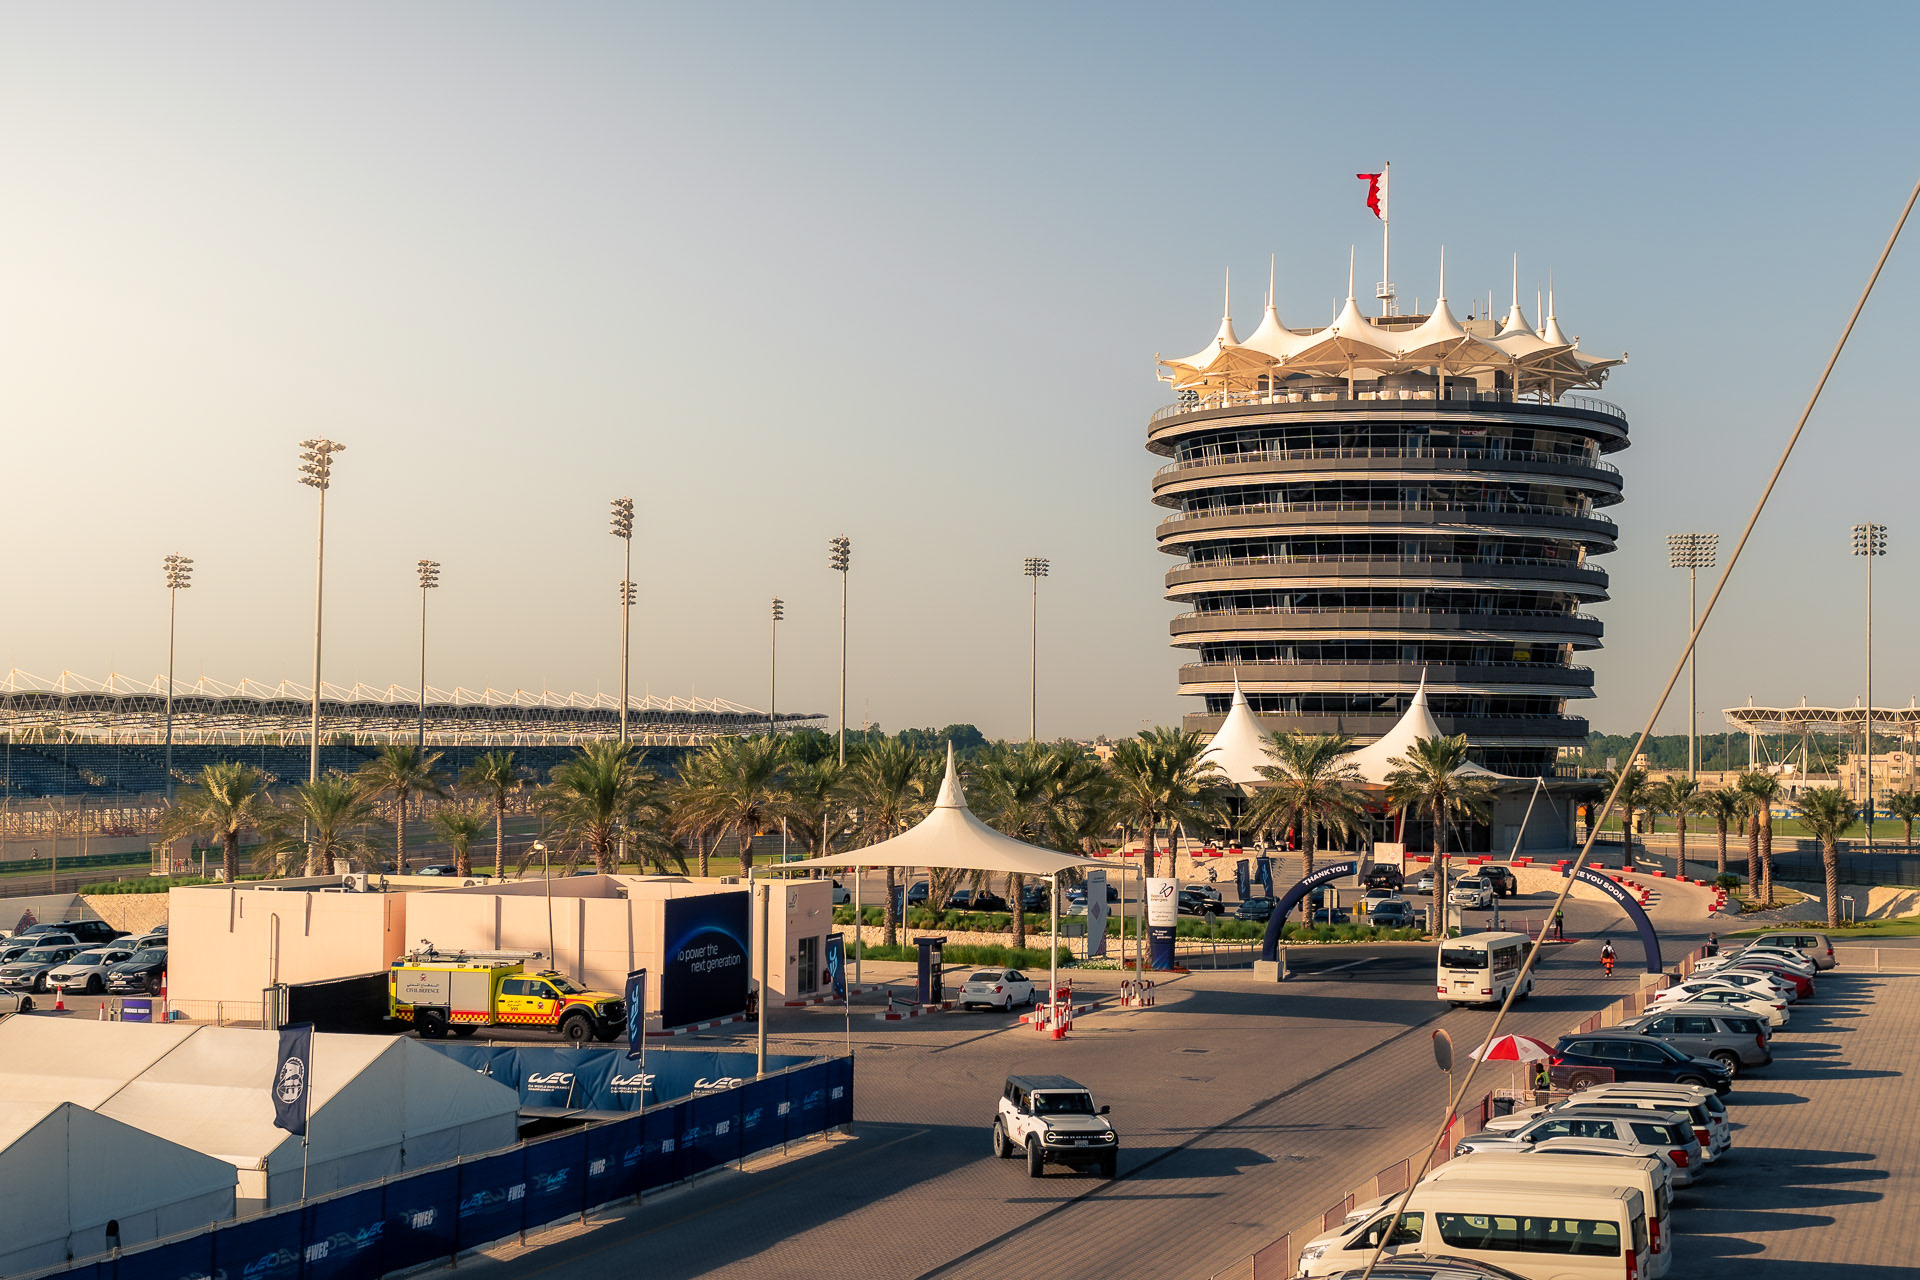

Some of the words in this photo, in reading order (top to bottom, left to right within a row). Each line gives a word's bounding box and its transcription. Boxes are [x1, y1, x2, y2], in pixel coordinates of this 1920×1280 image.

[1302, 868, 1330, 886] THANK
[1330, 865, 1348, 874] YOU
[1586, 874, 1603, 884] YOU
[1602, 882, 1625, 900] SOON
[685, 946, 706, 962] power
[708, 944, 718, 956] the
[691, 959, 706, 972] next
[707, 954, 740, 972] generation
[528, 1072, 574, 1084] WEC
[611, 1074, 656, 1085] WEC
[694, 1078, 742, 1089] WEC
[832, 1086, 843, 1099] #WEC
[716, 1120, 730, 1136] #WEC
[589, 1159, 606, 1176] #WEC
[508, 1183, 526, 1201] #WEC
[412, 1210, 434, 1229] #WEC
[306, 1241, 329, 1262] #WEC
